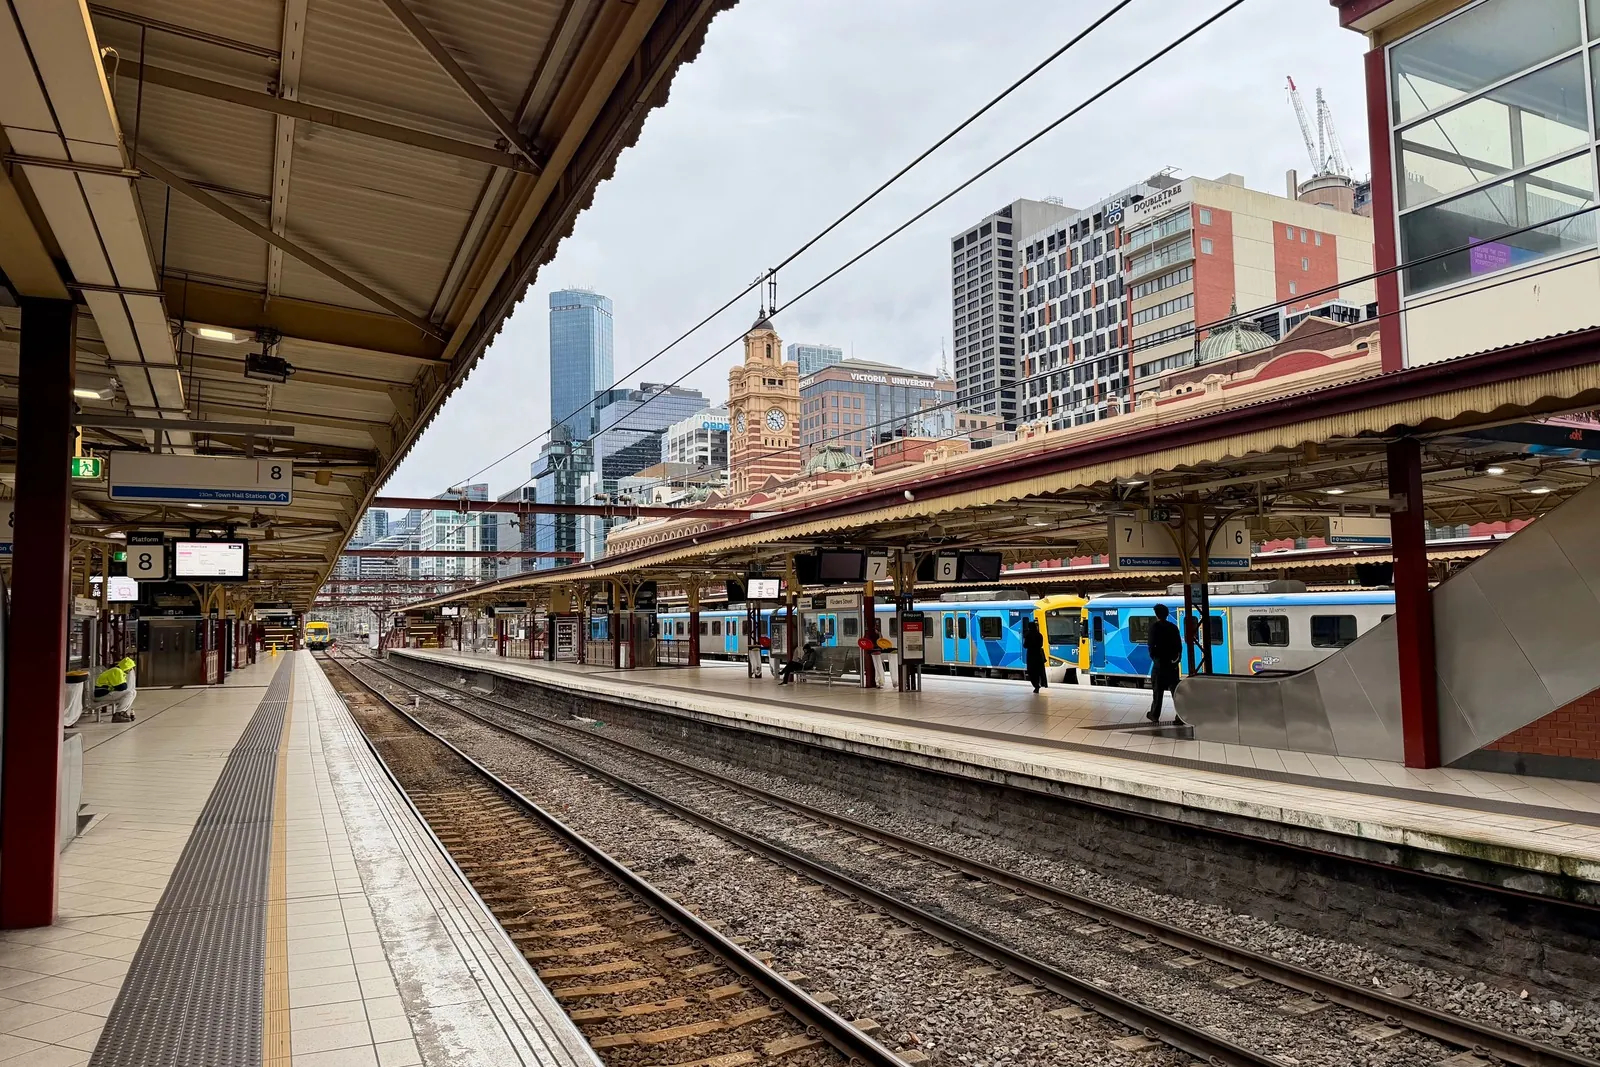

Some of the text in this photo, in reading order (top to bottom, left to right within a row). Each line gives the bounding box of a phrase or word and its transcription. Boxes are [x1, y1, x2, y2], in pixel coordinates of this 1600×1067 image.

[850, 372, 935, 388] VICTORIA UNIVERSITY
[270, 465, 282, 480] 8
[1333, 520, 1338, 530] 7
[1124, 528, 1133, 542] 7
[1235, 530, 1243, 545] 6
[138, 553, 153, 571] 8
[873, 562, 881, 576] 7
[943, 562, 951, 576] 6
